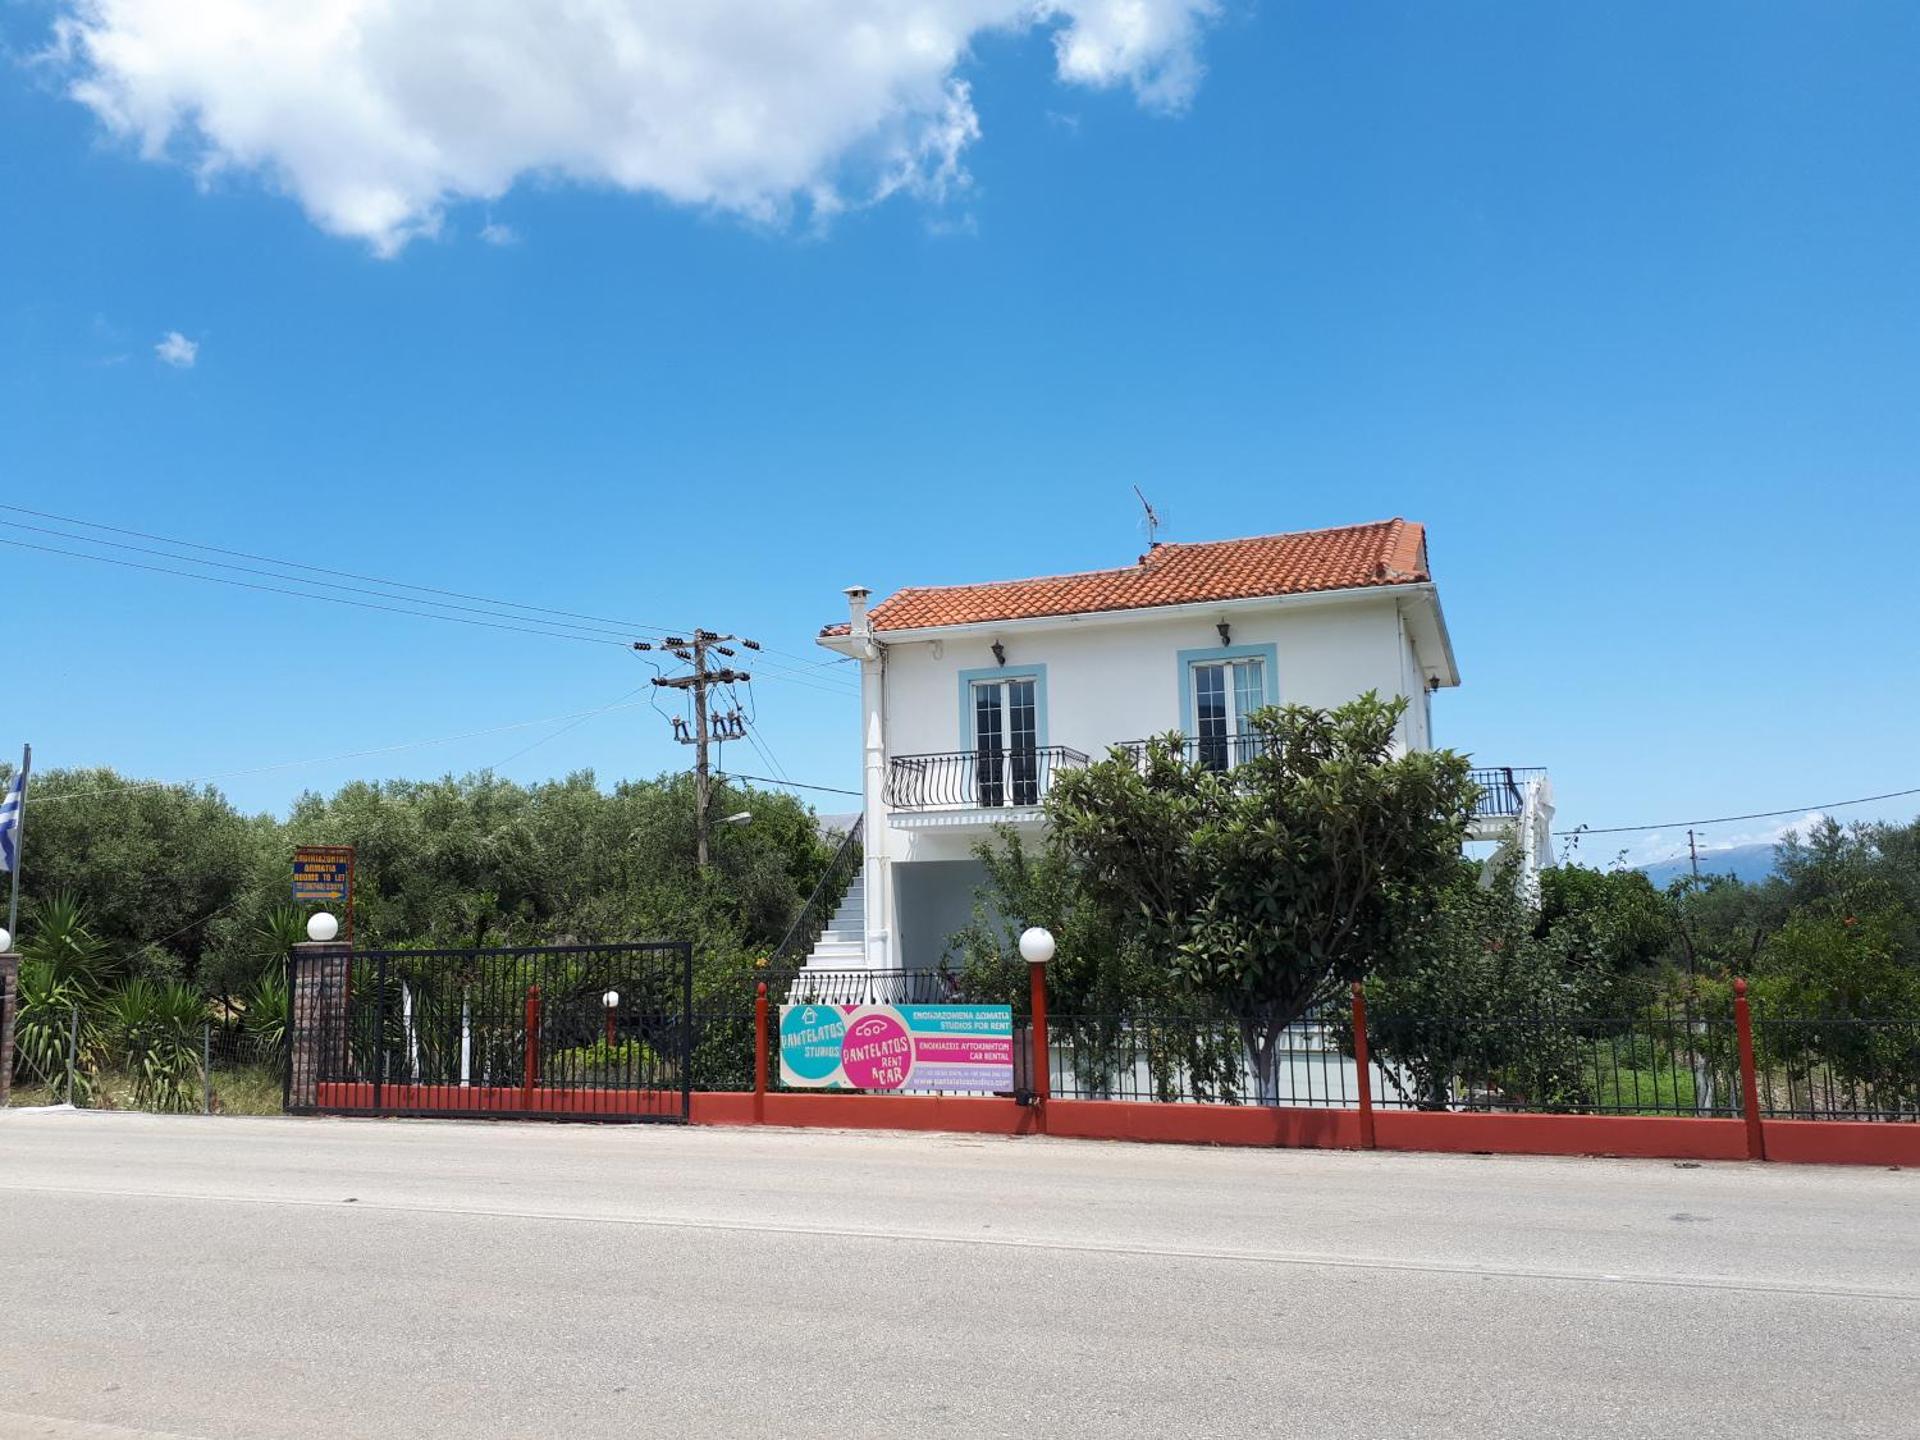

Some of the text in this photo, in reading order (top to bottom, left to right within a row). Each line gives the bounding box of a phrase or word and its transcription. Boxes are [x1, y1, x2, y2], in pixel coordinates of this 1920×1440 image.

[293, 873, 345, 881] ROOMS TO LET
[975, 1011, 1009, 1020] ΔΩΜΑΤΙΑ
[941, 1021, 1010, 1030] STUDIOS FOR RENT
[780, 1021, 846, 1048] PANTELATOS
[804, 1046, 840, 1058] STUDIOS
[842, 1036, 909, 1064] PANTELATOS
[881, 1056, 902, 1067] RENT
[969, 1052, 1009, 1061] CAR RENTAL
[872, 1067, 879, 1079] A
[879, 1067, 903, 1085] CAR
